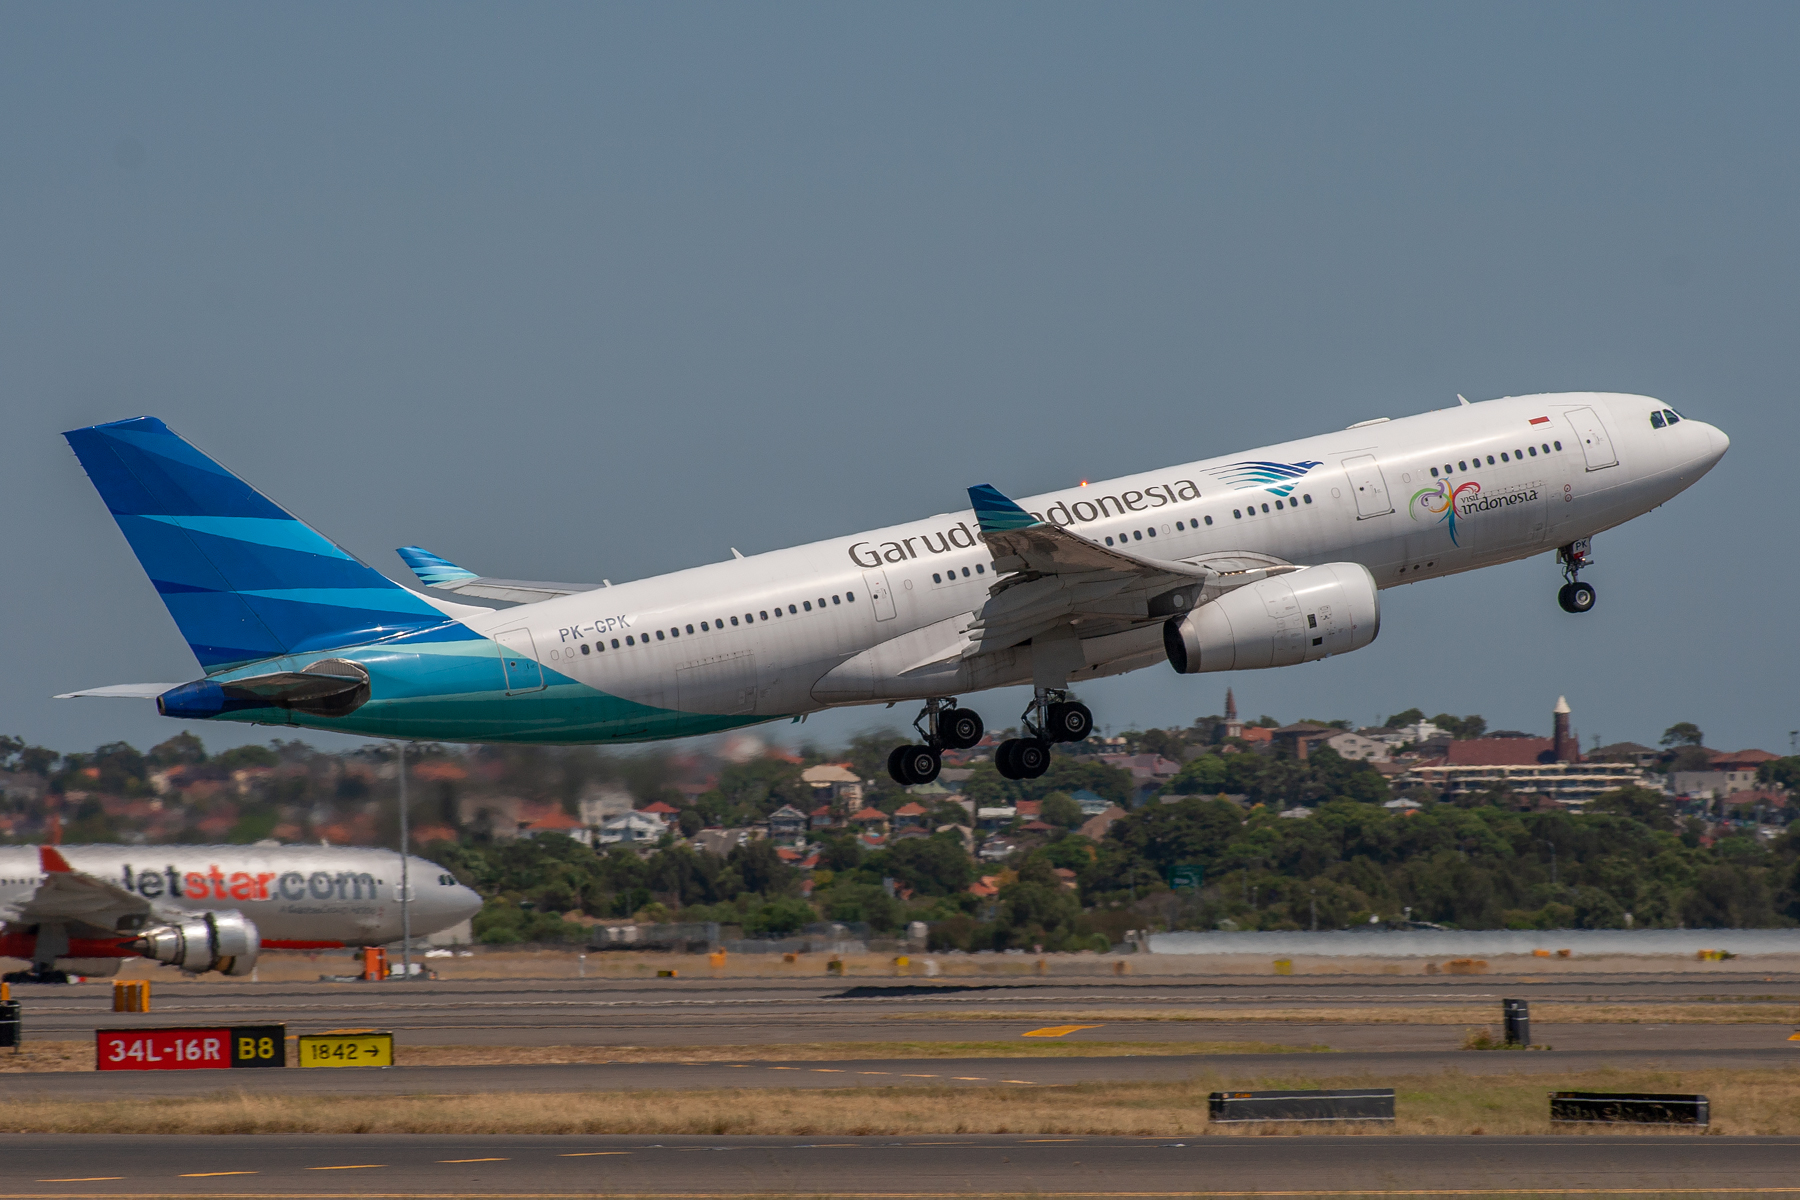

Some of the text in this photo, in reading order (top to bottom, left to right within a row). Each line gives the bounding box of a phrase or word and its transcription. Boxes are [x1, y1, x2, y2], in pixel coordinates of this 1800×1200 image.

[1030, 480, 1202, 527] donesia
[1461, 490, 1539, 515] indonesia
[1575, 540, 1588, 551] PK
[559, 614, 631, 643] PK-GPK
[108, 1037, 275, 1063] 34L-16R B8
[311, 1043, 359, 1060] 1842
